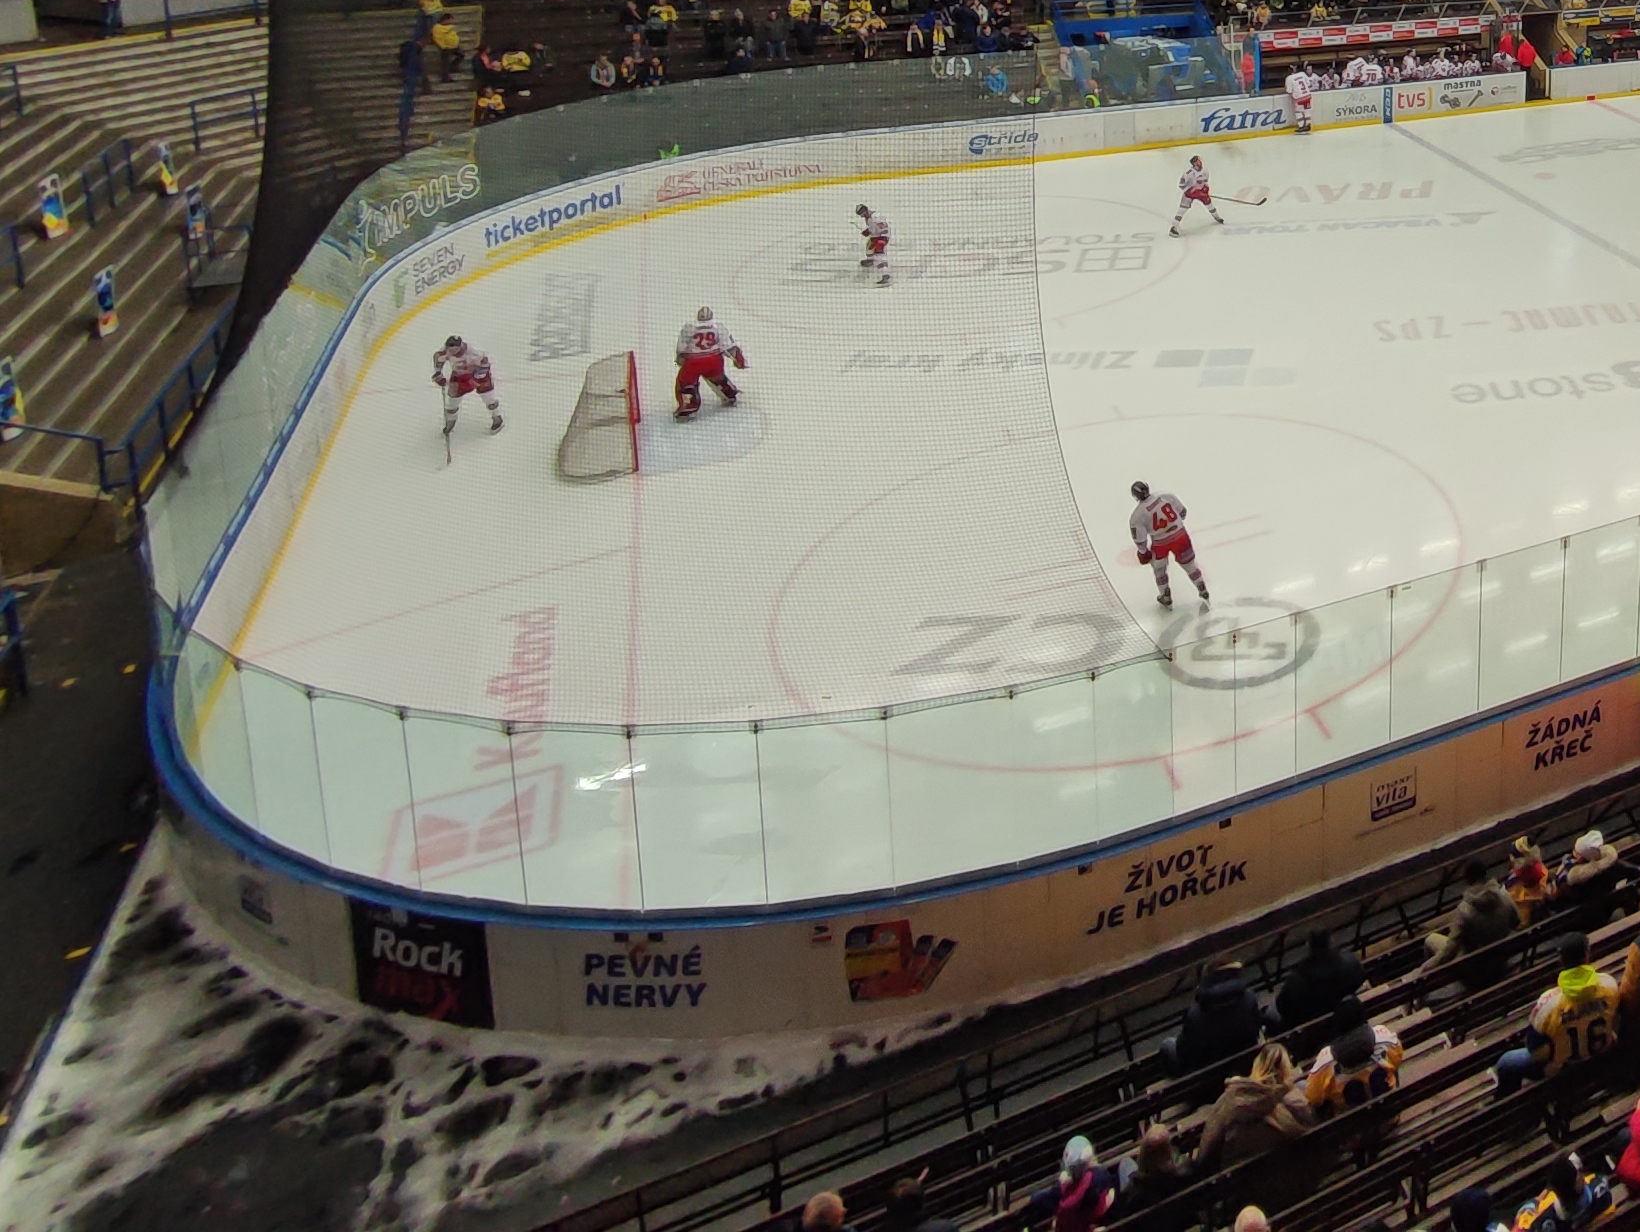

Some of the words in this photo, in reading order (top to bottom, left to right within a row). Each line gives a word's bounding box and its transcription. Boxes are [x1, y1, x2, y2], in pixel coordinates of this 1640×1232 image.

[1202, 106, 1287, 133] fatra
[1335, 103, 1378, 117] SÝKORA
[485, 184, 622, 248] ticketportal
[412, 243, 455, 277] SEVEN
[415, 255, 466, 296] ENERGY
[1152, 502, 1178, 532] 48
[1526, 699, 1604, 749] ŽÁDNÁ
[1534, 729, 1594, 771] KŘEČ
[1375, 781, 1409, 807] vita
[1125, 843, 1214, 893] ŽIVOT
[1087, 904, 1124, 936] JE
[1136, 860, 1247, 920] HOŘČÍK
[373, 928, 463, 978] Rock
[584, 945, 702, 978] PEVNÉ
[586, 982, 708, 1009] NERVY
